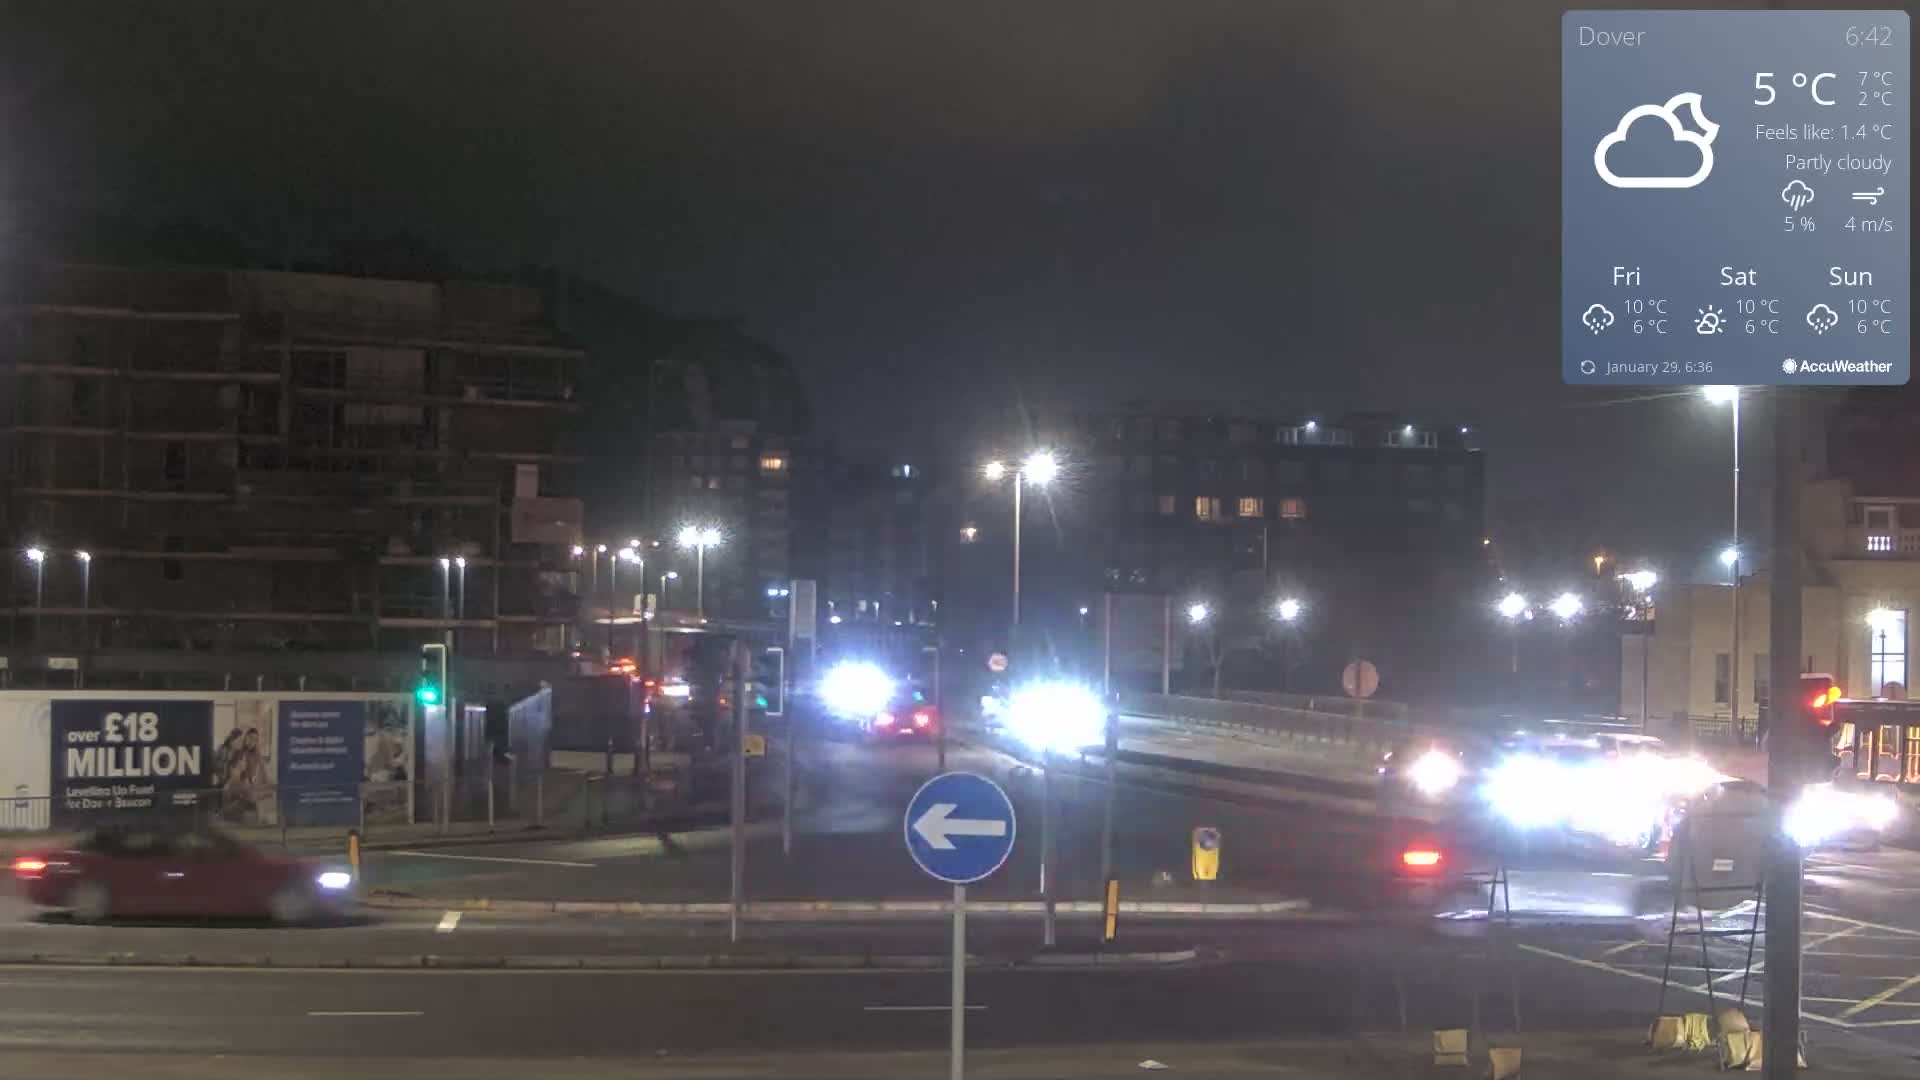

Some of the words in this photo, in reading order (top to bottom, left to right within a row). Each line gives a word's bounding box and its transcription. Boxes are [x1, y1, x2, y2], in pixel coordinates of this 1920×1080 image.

[67, 730, 100, 742] over
[104, 711, 158, 742] £18
[67, 746, 201, 777] MILLION
